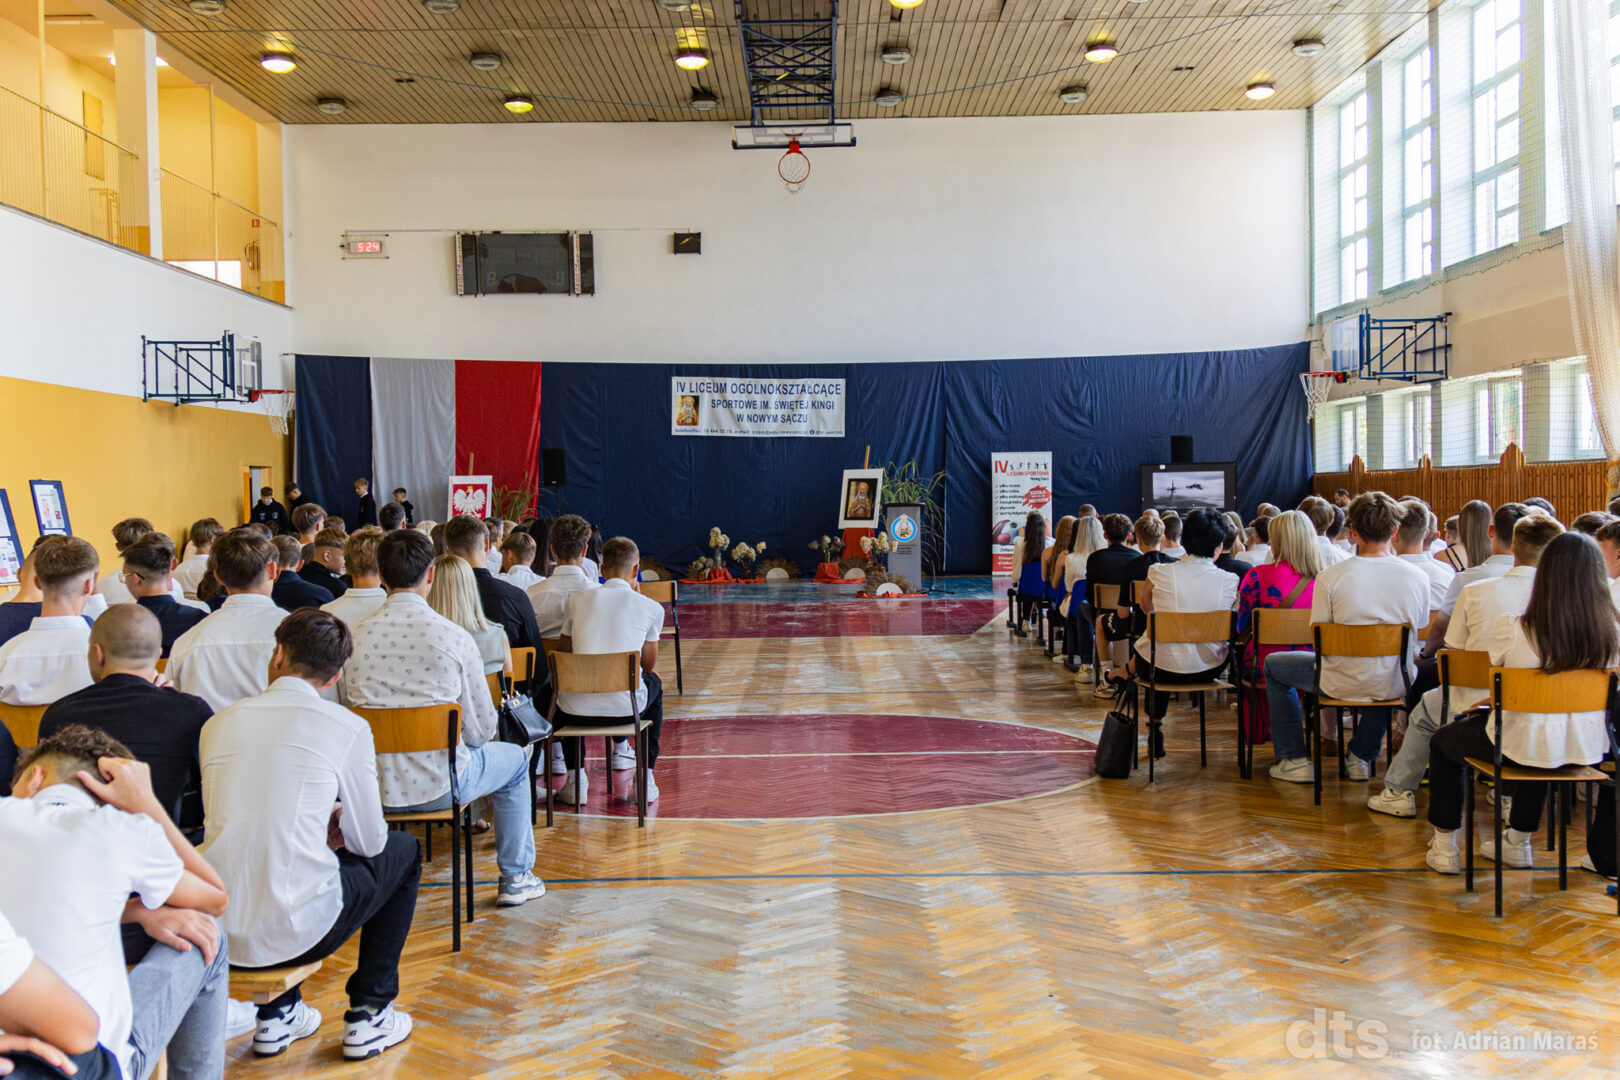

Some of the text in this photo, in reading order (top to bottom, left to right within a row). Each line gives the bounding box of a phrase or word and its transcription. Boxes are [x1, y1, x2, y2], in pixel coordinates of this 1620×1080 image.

[676, 380, 842, 397] IV LICEUM OGÓLNOKSZTAŁCĄCE
[711, 398, 835, 411] SPORTOWE IM. ŚWIĘTEJ KINGI
[736, 413, 808, 425] W NOWYM SĄCZU
[994, 460, 1008, 473] IV
